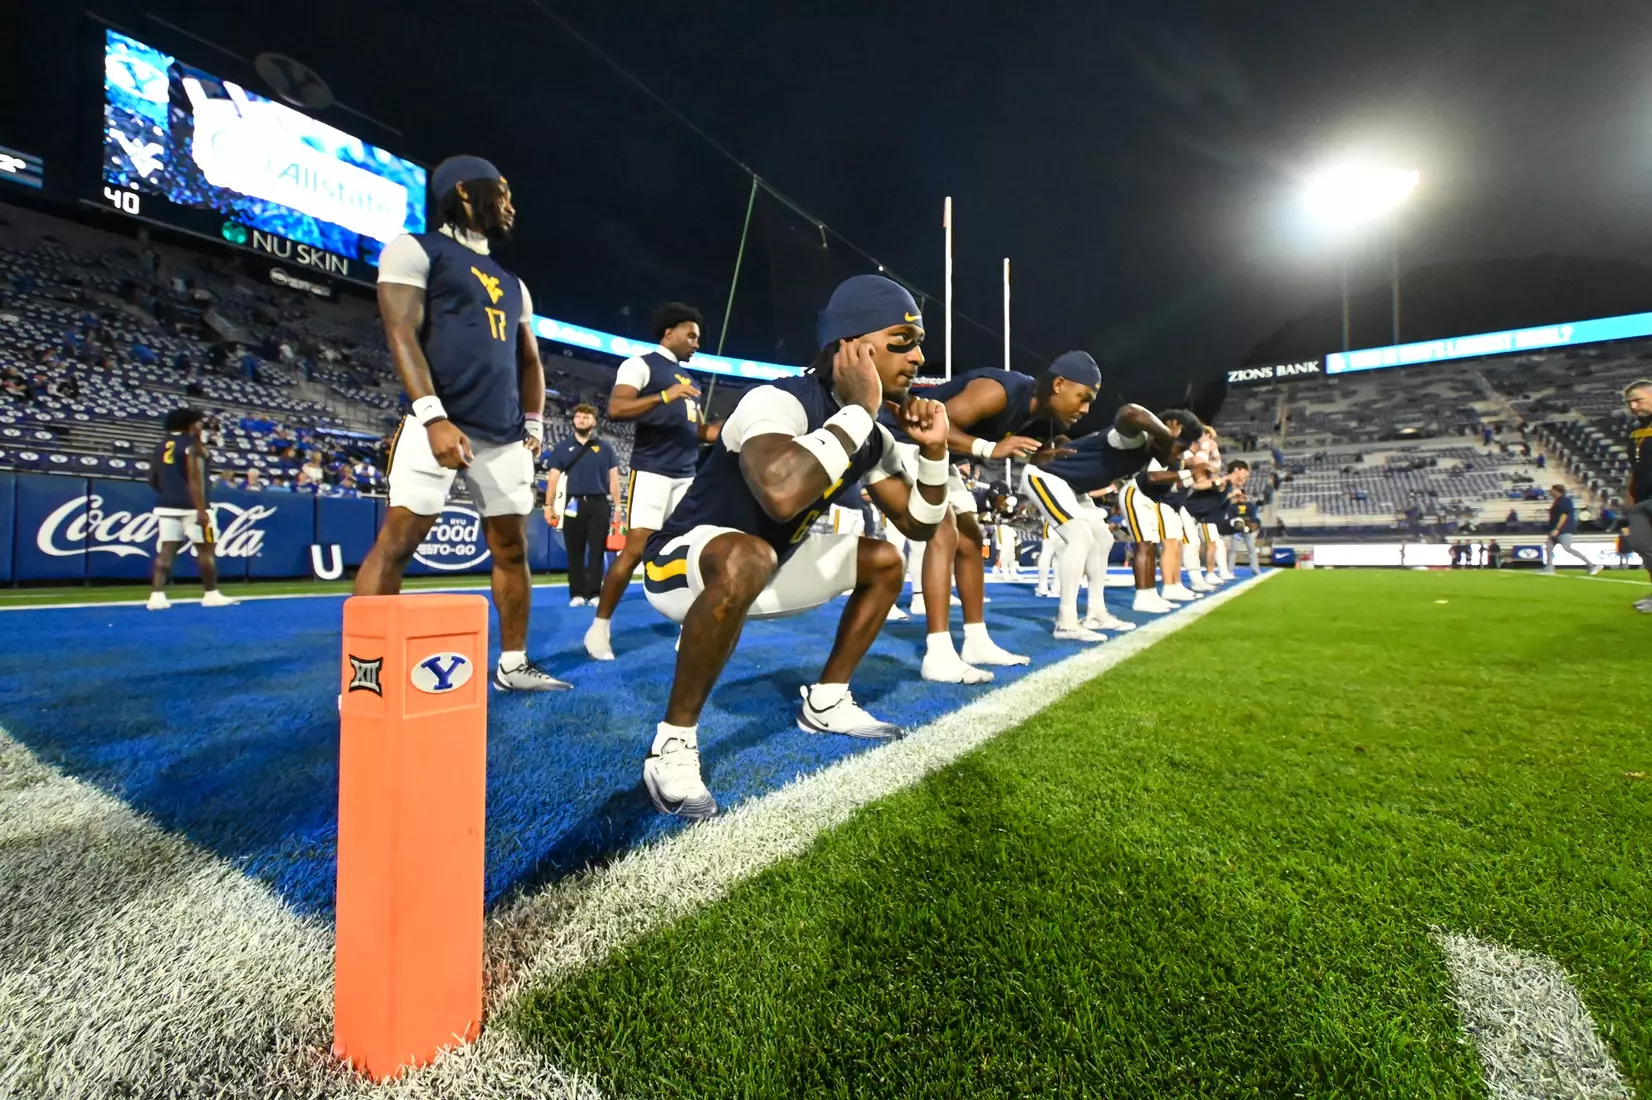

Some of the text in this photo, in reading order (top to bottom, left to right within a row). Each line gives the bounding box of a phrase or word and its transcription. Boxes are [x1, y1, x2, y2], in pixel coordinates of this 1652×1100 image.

[104, 187, 140, 215] 40
[278, 163, 390, 214] Allstate
[253, 230, 349, 276] NU SKIN
[1227, 366, 1274, 383] ZIONS
[1276, 360, 1320, 377] BANK
[163, 440, 176, 464] 2
[37, 494, 277, 558] Cocala
[311, 544, 344, 580] U
[420, 655, 467, 691] Y
